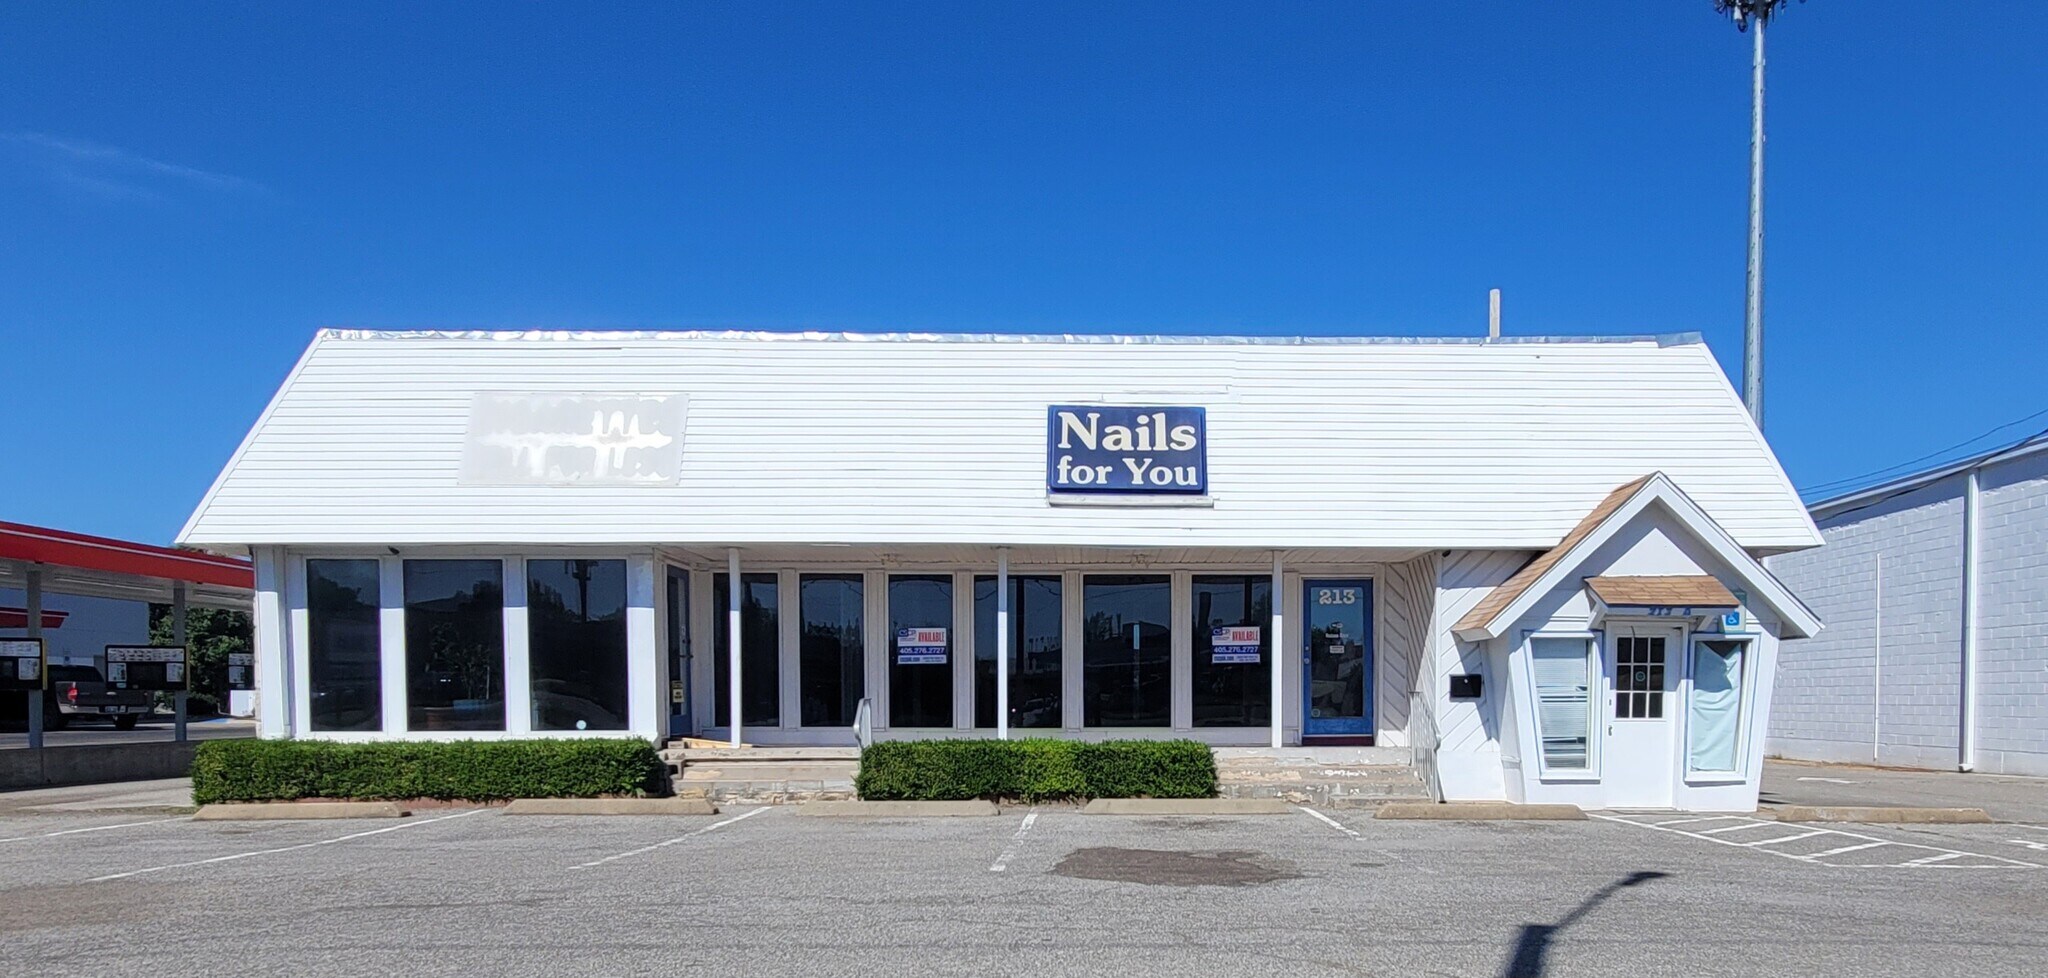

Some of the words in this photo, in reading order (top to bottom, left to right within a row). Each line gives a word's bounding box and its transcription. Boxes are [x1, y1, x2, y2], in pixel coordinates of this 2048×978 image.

[1057, 411, 1197, 451] Nails
[1057, 455, 1113, 485] for
[1122, 457, 1198, 486] You
[1319, 589, 1356, 605] 213
[918, 631, 945, 643] AVAILABLE
[1232, 630, 1259, 642] AVAILABLE
